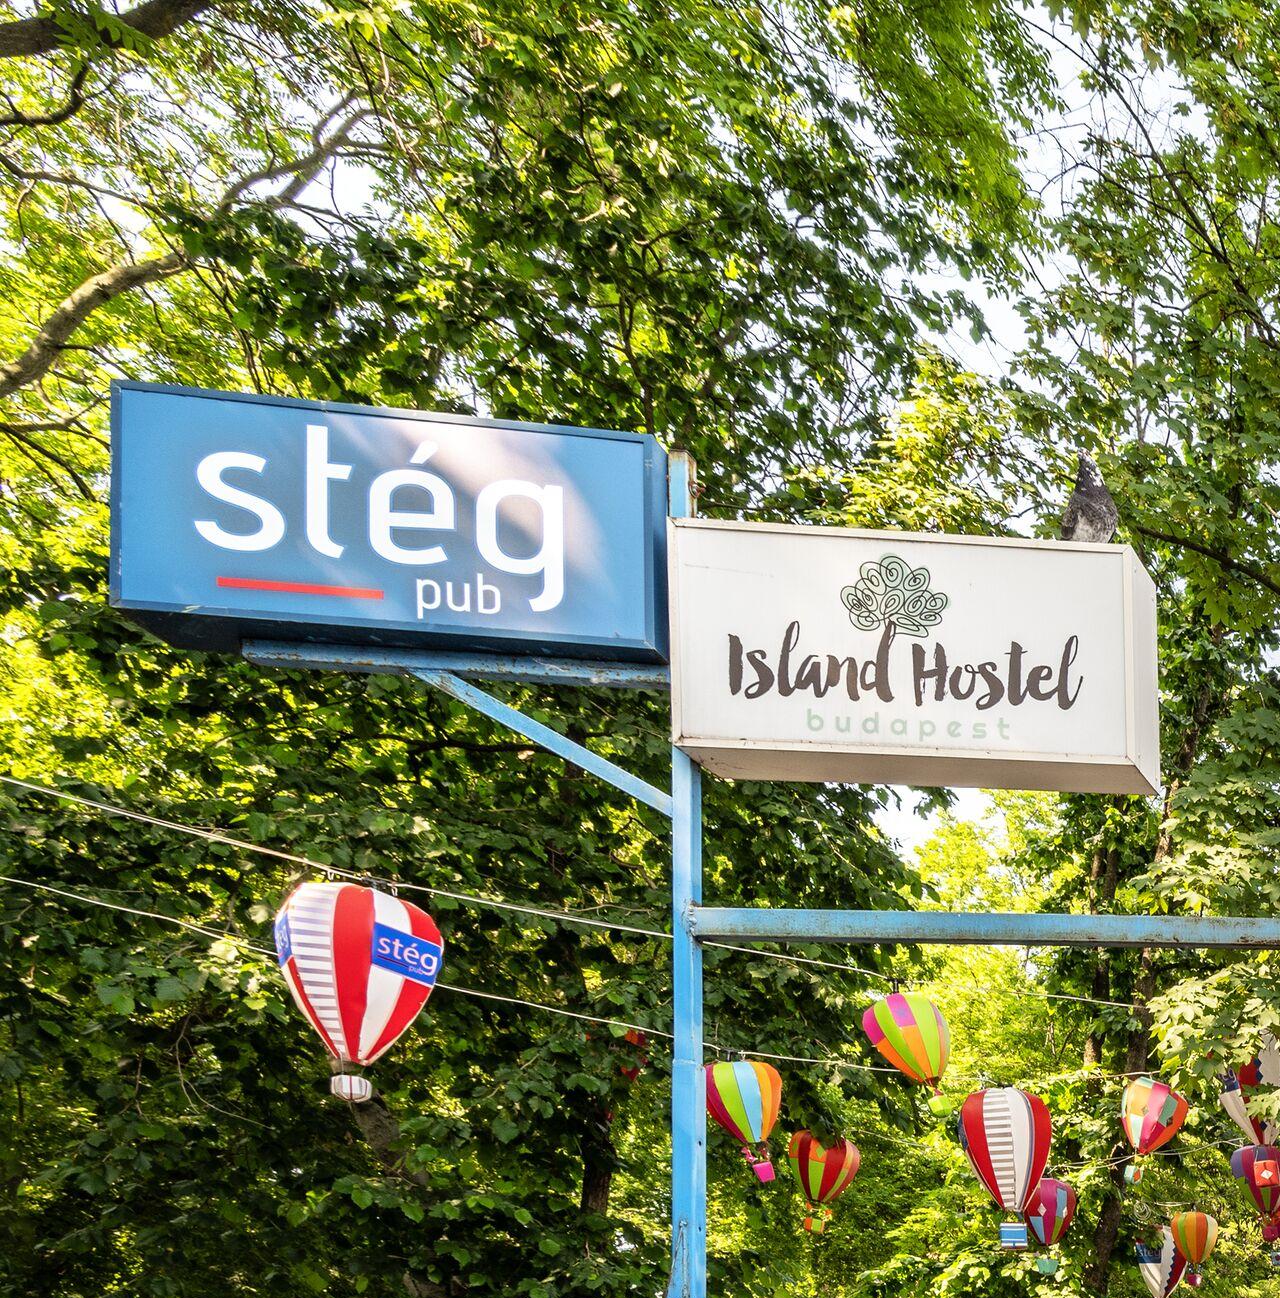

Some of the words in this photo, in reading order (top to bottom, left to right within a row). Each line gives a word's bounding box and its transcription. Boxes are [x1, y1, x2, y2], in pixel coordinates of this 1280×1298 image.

[194, 424, 564, 612] stég
[416, 573, 501, 618] pub
[727, 621, 894, 702] Island
[911, 635, 1083, 710] Hostel
[806, 707, 1011, 741] budapest
[378, 936, 438, 976] stég
[408, 965, 424, 975] pub
